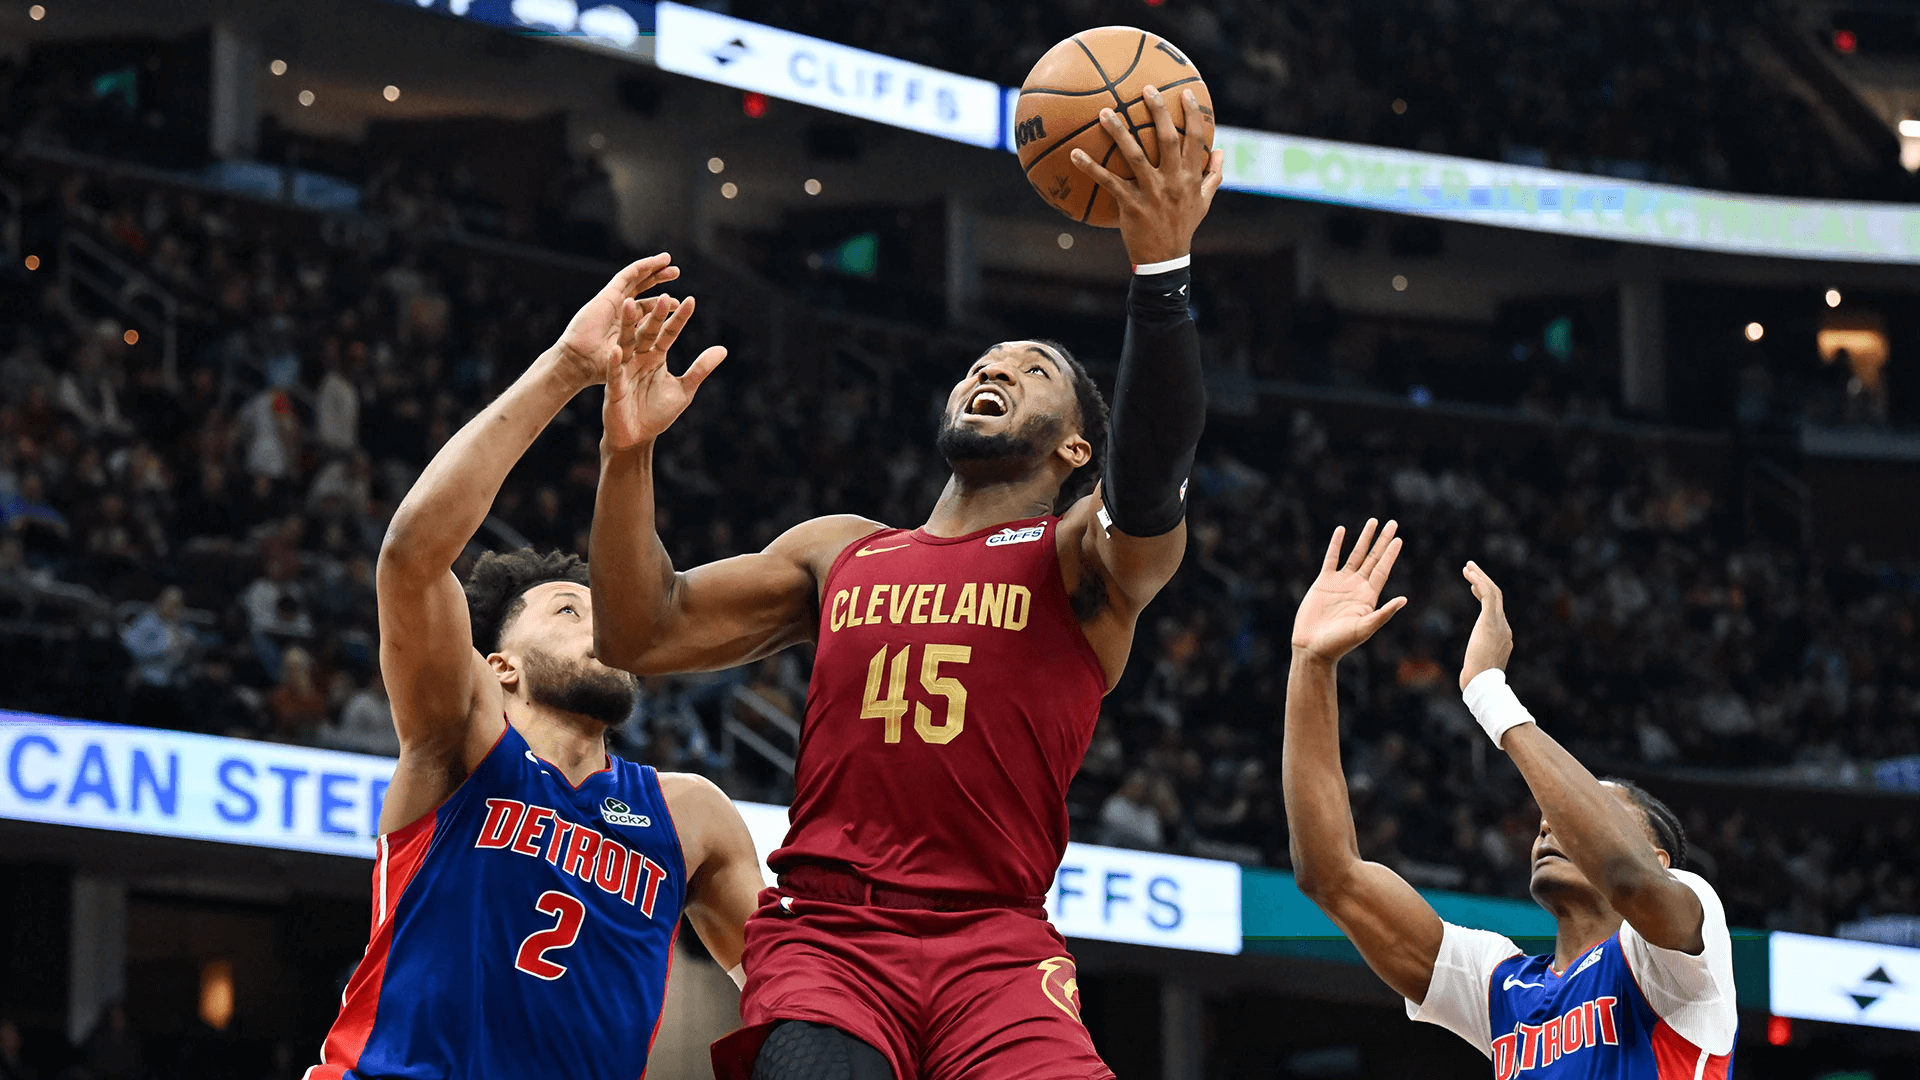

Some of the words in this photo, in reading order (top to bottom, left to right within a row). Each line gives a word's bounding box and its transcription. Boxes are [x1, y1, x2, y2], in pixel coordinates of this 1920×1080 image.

[788, 49, 961, 123] CLIFFS
[1015, 115, 1047, 150] on
[989, 528, 1042, 544] CLIFFS
[830, 582, 1032, 633] CLEVELAND
[860, 643, 972, 745] 45
[7, 734, 181, 818] CAN
[475, 798, 667, 920] DETROIT
[515, 890, 586, 981] 2
[1491, 996, 1619, 1080] DTROIT
